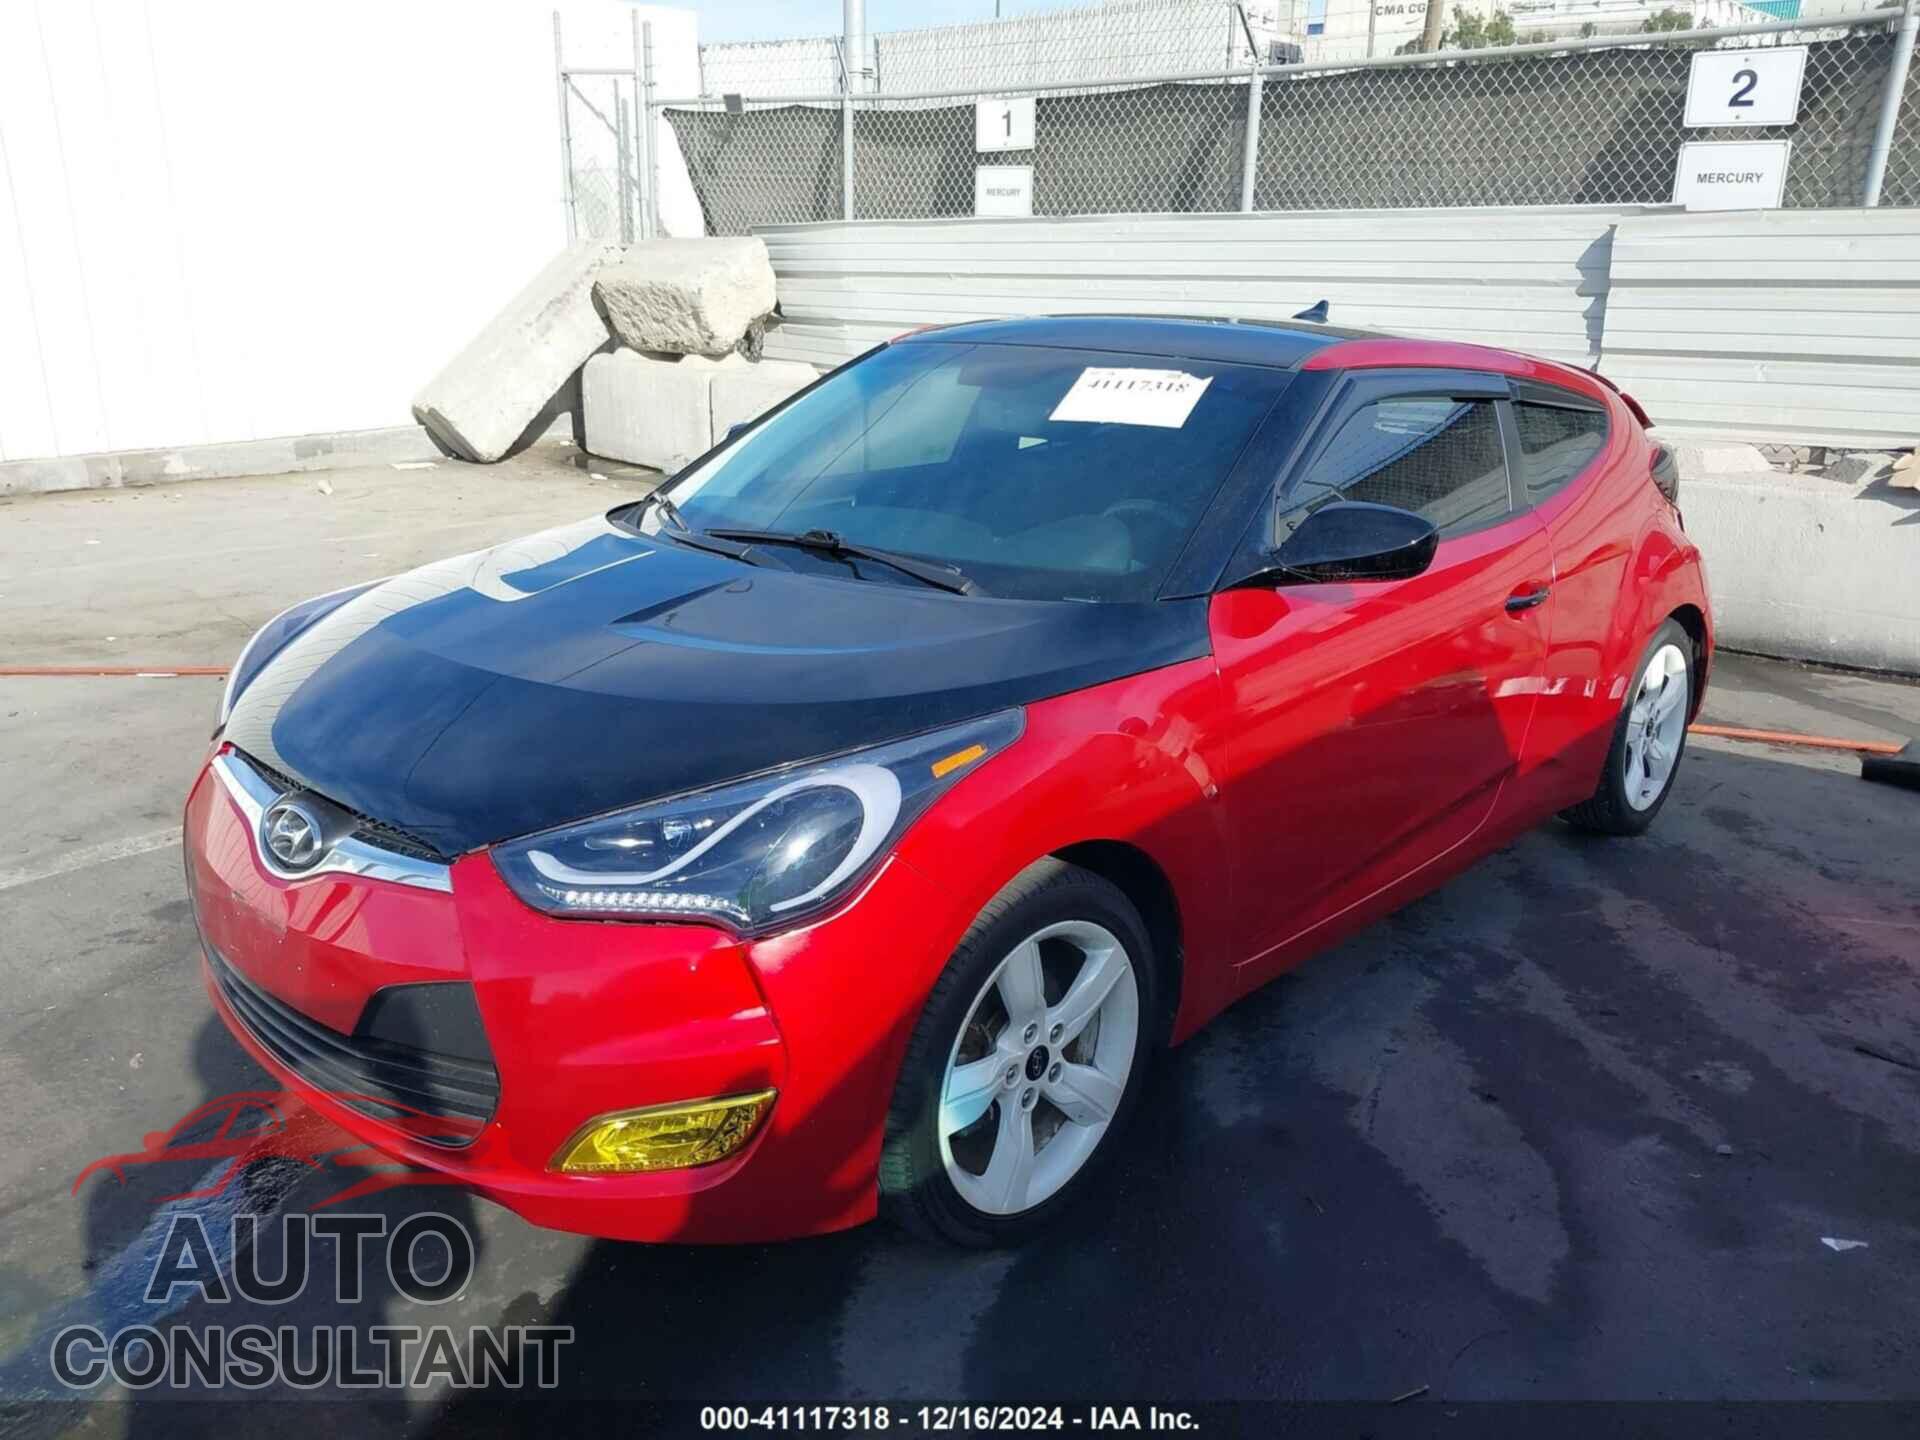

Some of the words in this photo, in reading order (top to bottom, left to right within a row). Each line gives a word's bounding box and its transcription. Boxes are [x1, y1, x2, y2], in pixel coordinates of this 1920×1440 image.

[1375, 4, 1404, 16] CMA
[1408, 3, 1426, 14] CG
[1728, 69, 1758, 107] 2
[1002, 109, 1012, 137] 1
[1696, 172, 1764, 184] MERCURY
[986, 187, 1022, 197] MERCURY
